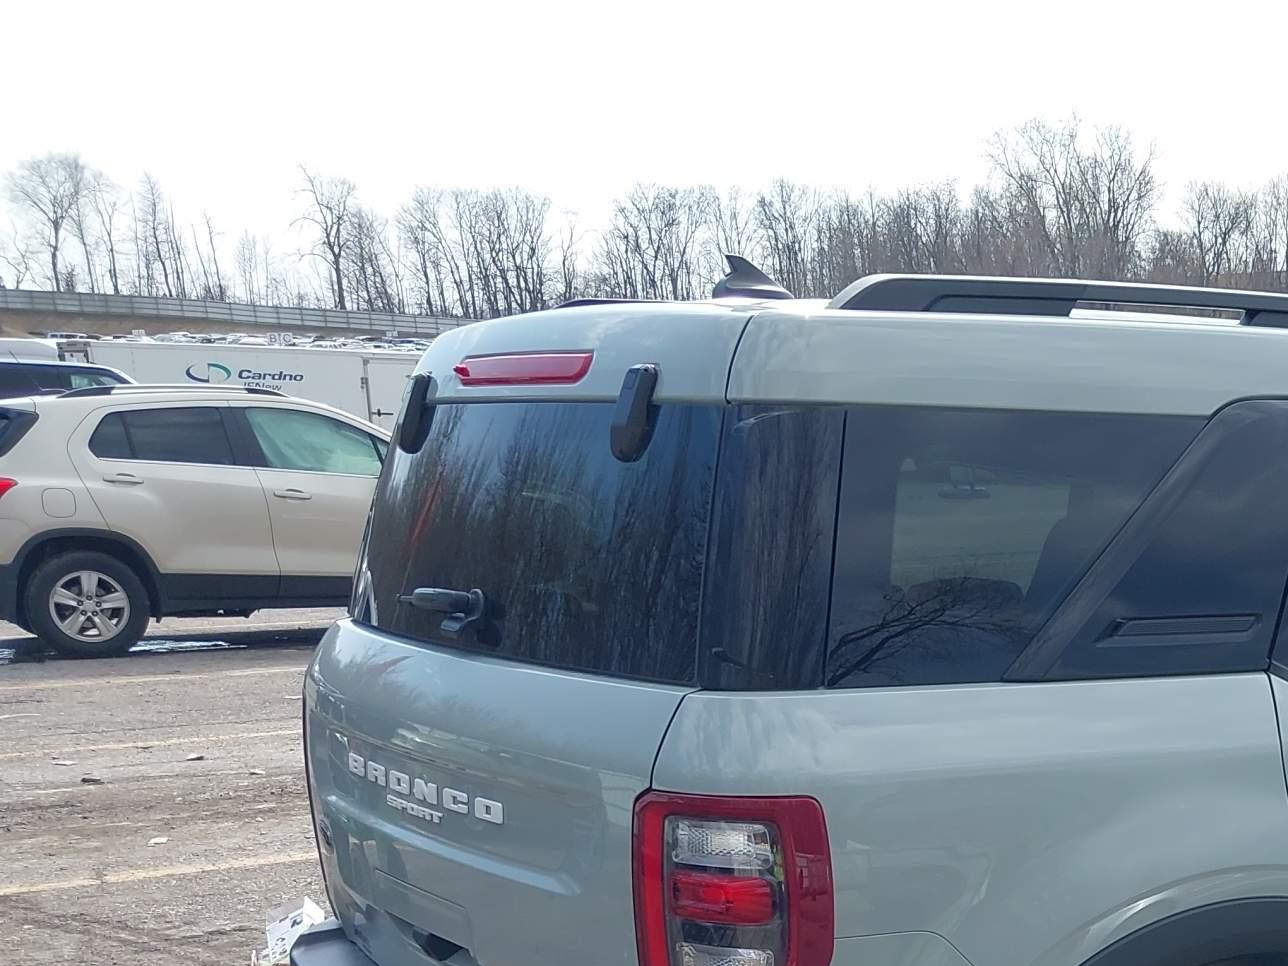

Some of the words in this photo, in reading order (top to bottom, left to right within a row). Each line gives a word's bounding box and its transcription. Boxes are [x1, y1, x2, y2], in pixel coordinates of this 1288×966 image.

[238, 369, 304, 382] Cardno
[348, 752, 504, 825] BRONCO
[386, 794, 444, 824] SPORT
